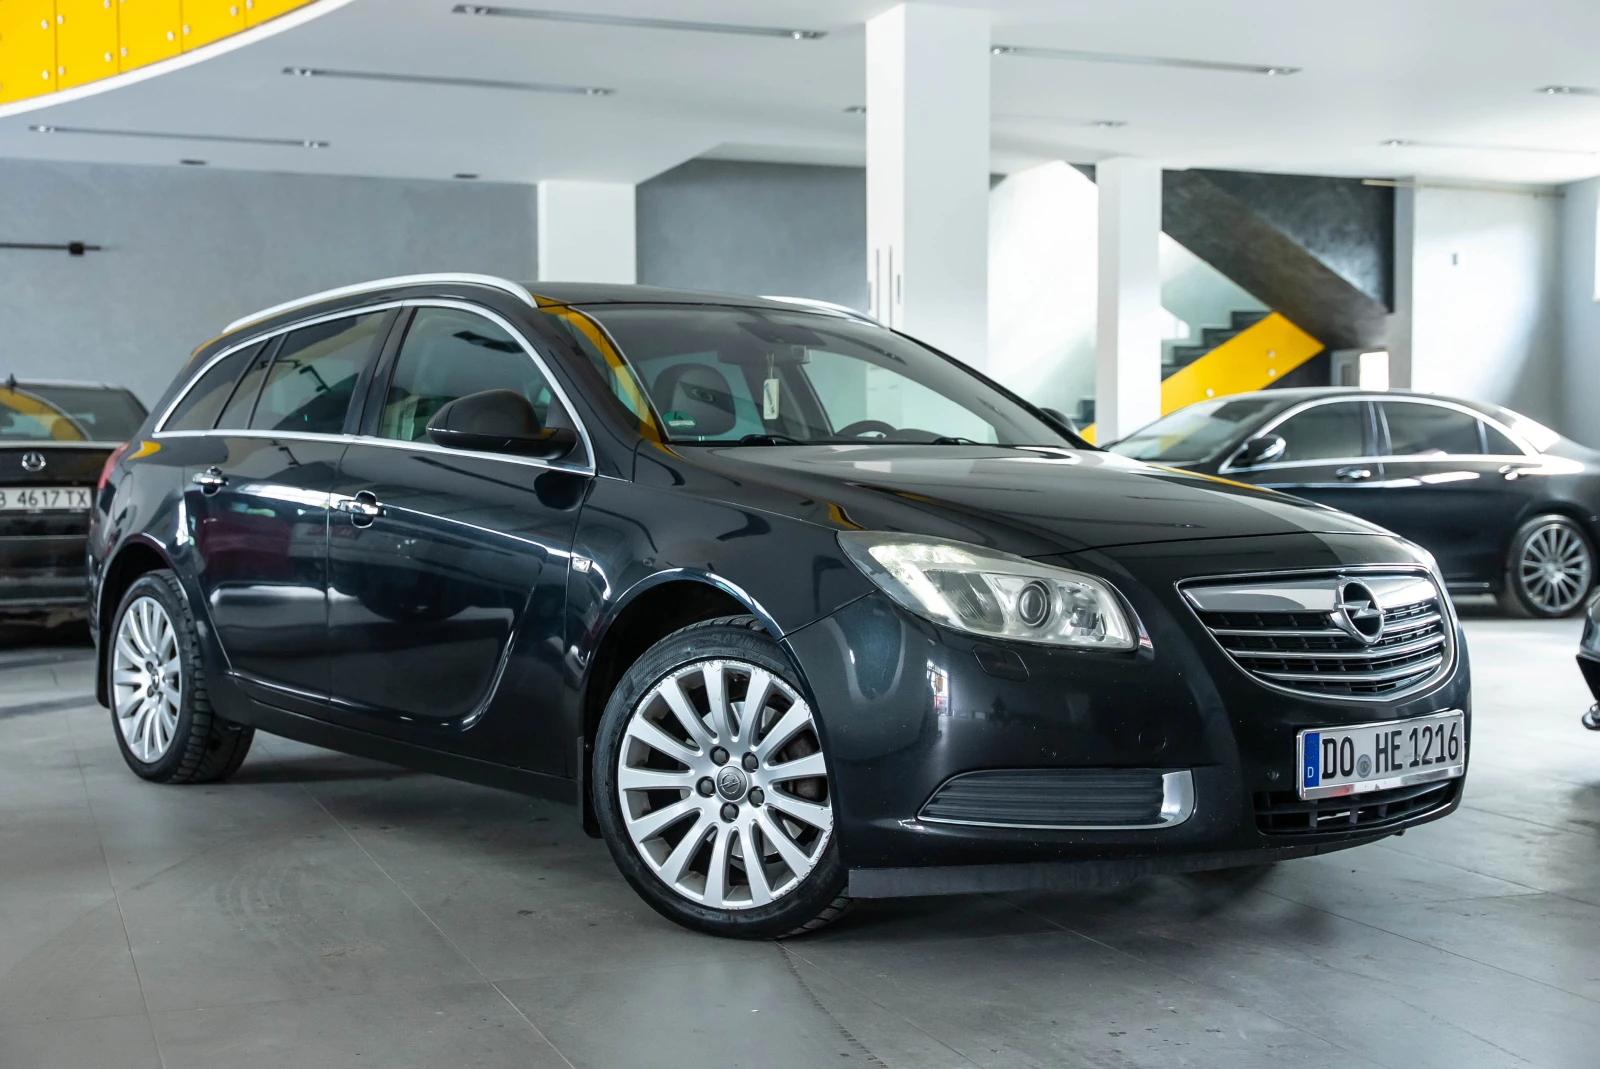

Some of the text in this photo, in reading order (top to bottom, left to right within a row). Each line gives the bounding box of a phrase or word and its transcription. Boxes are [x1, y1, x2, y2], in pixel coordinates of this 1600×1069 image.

[17, 490, 60, 507] 4617
[65, 490, 87, 506] TX
[1321, 721, 1459, 779] DO HE 1216
[1307, 766, 1314, 779] D
